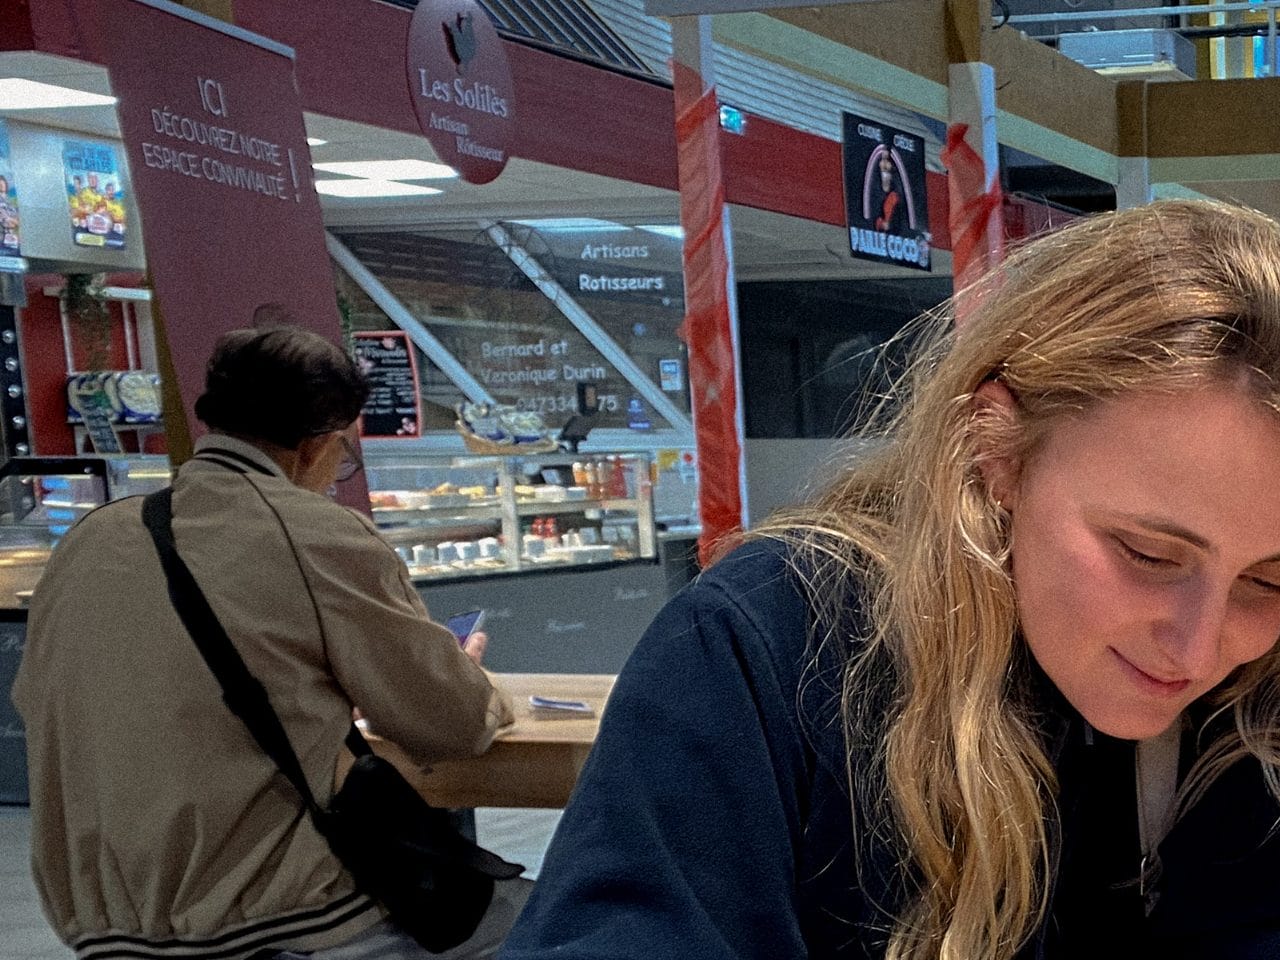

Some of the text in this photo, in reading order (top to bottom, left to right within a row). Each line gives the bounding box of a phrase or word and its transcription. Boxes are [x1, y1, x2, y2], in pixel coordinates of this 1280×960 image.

[197, 76, 228, 118] ICI
[418, 68, 450, 102] Les
[151, 106, 283, 166] DÉCOUVREZ NOTRE
[142, 142, 201, 178] ESPACE
[581, 243, 648, 259] Artisans
[481, 339, 569, 358] Bernard et
[563, 364, 607, 381] Durin
